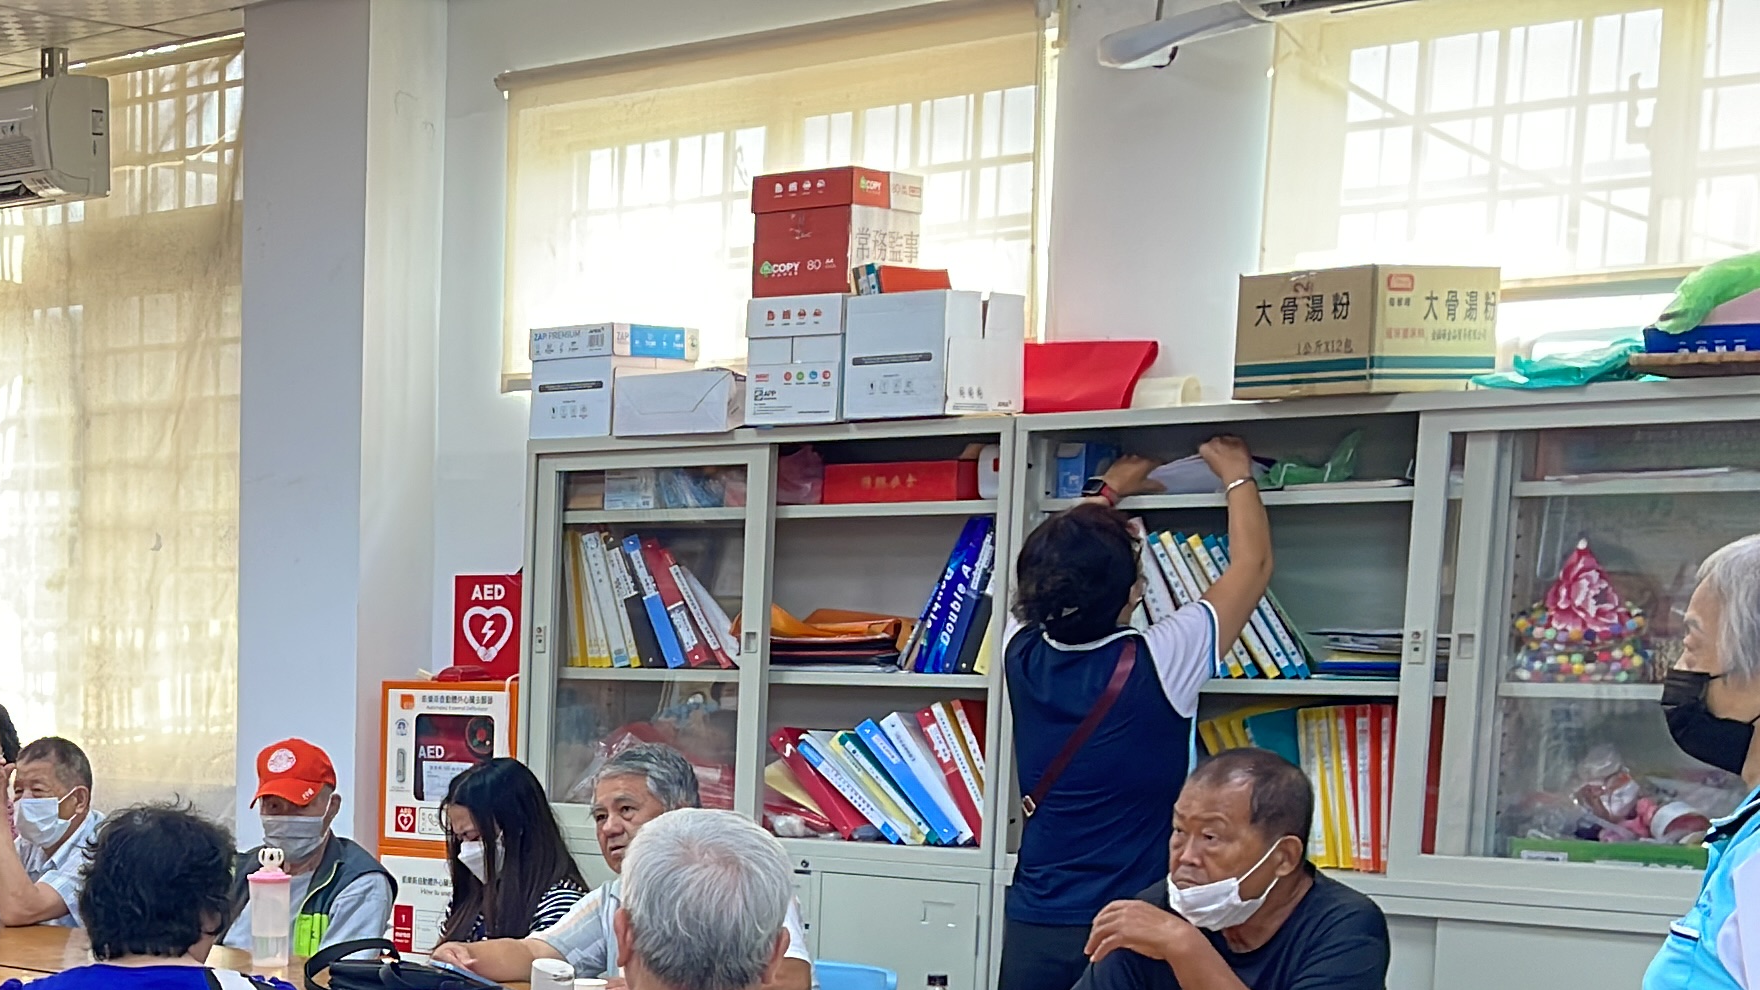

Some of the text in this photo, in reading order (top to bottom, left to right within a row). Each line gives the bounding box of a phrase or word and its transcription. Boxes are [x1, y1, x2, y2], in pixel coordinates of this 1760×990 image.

[855, 227, 920, 264] 常務監事
[772, 261, 800, 273] COPY
[806, 259, 822, 270] 80
[1254, 291, 1351, 327] 大骨湯粉
[1423, 289, 1496, 322] 大骨湯粉
[471, 584, 506, 601] AED
[939, 563, 973, 647] Double A
[418, 745, 446, 759] AED
